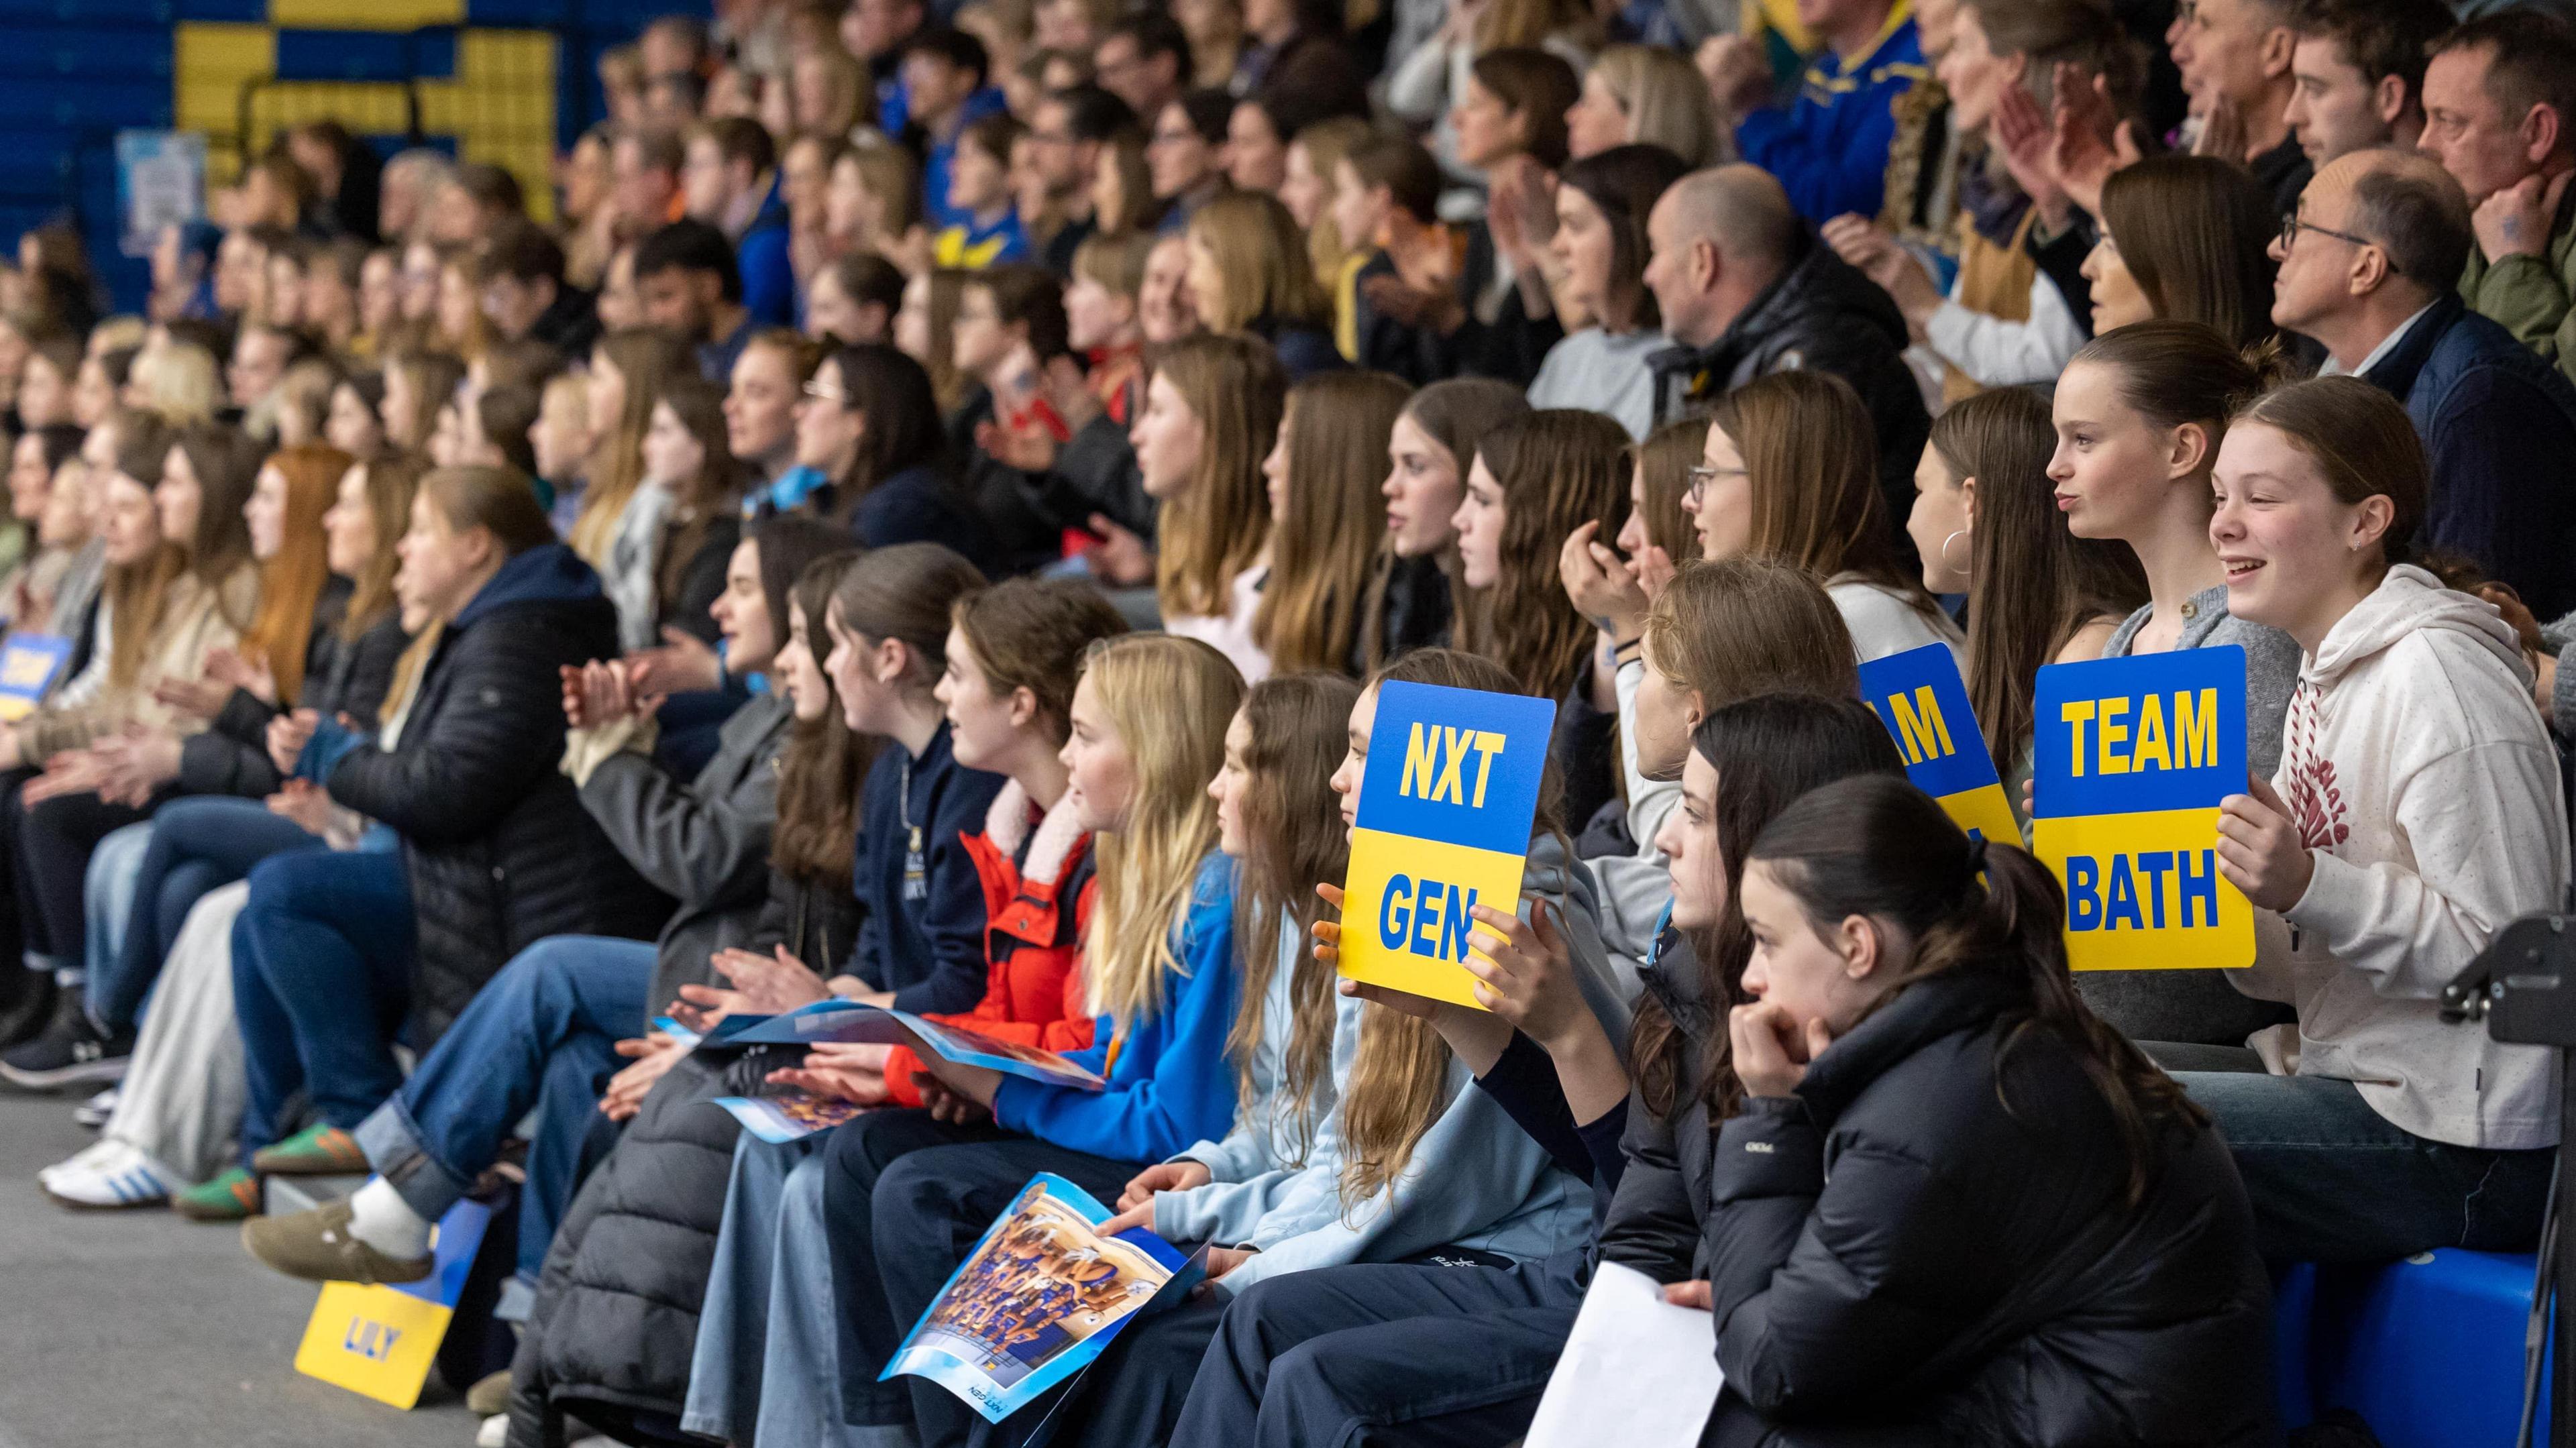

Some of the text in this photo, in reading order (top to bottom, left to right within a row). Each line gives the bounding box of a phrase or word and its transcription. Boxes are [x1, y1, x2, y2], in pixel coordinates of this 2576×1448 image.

[1399, 722, 1507, 808] NXT
[2061, 687, 2218, 777] TEAM
[1379, 873, 1478, 964] GEN
[2066, 848, 2219, 932] BATH
[343, 1314, 402, 1363] LILY
[968, 1386, 986, 1400] GEN
[983, 1400, 1004, 1413] NXT
